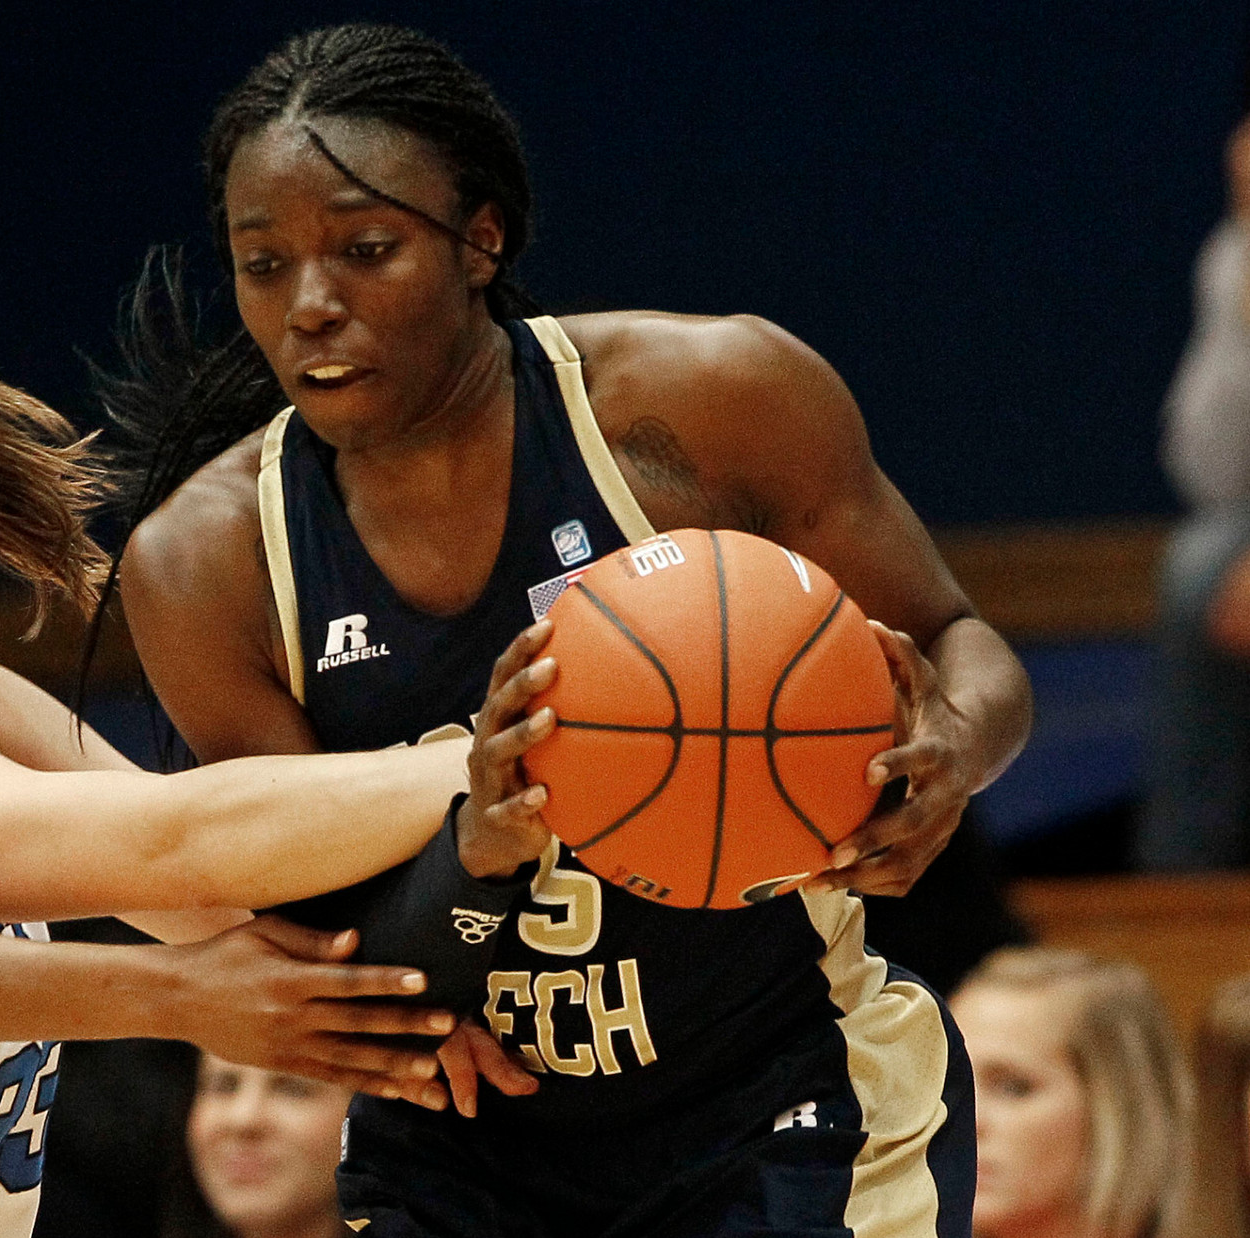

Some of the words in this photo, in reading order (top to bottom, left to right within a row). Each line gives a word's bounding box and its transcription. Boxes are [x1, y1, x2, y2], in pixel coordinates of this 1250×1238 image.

[324, 613, 368, 656] R
[316, 643, 390, 673] RUSSELL
[483, 958, 658, 1077] ECH
